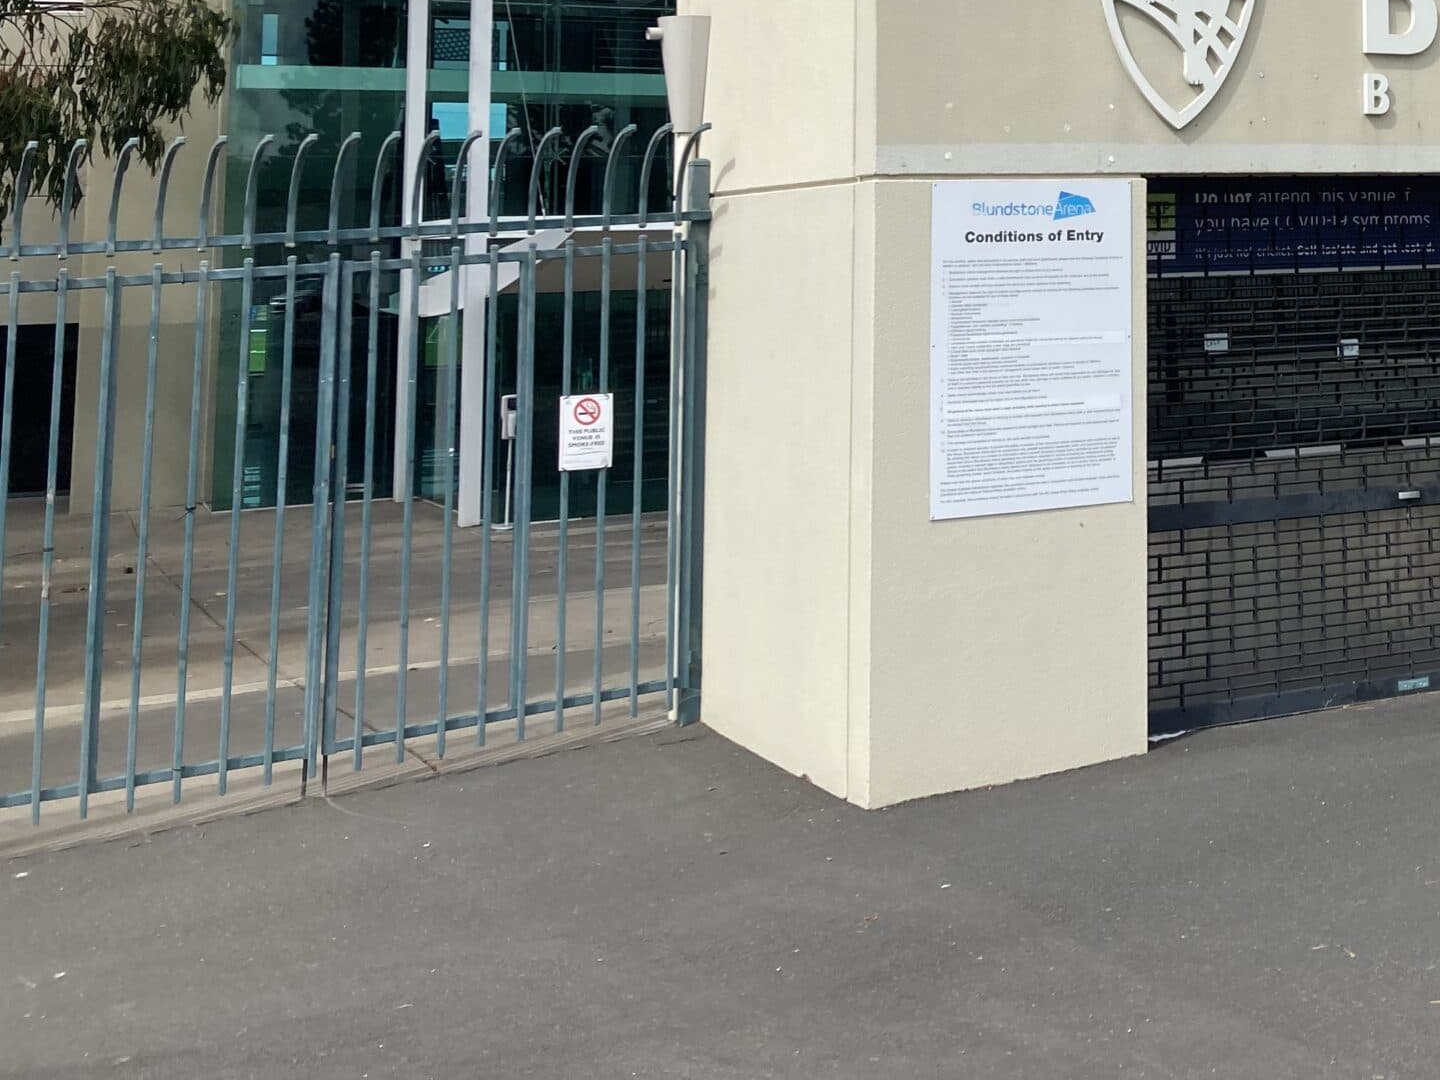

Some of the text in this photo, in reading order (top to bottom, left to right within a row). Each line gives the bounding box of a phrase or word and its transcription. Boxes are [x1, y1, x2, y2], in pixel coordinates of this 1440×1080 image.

[1195, 192, 1218, 204] Do
[1318, 190, 1344, 203] his
[1195, 216, 1225, 236] you
[1231, 215, 1270, 231] have
[1352, 214, 1431, 232] symptoms
[965, 229, 1104, 243] Conditions of Entry
[1236, 246, 1252, 258] no
[1401, 241, 1435, 253] estd.
